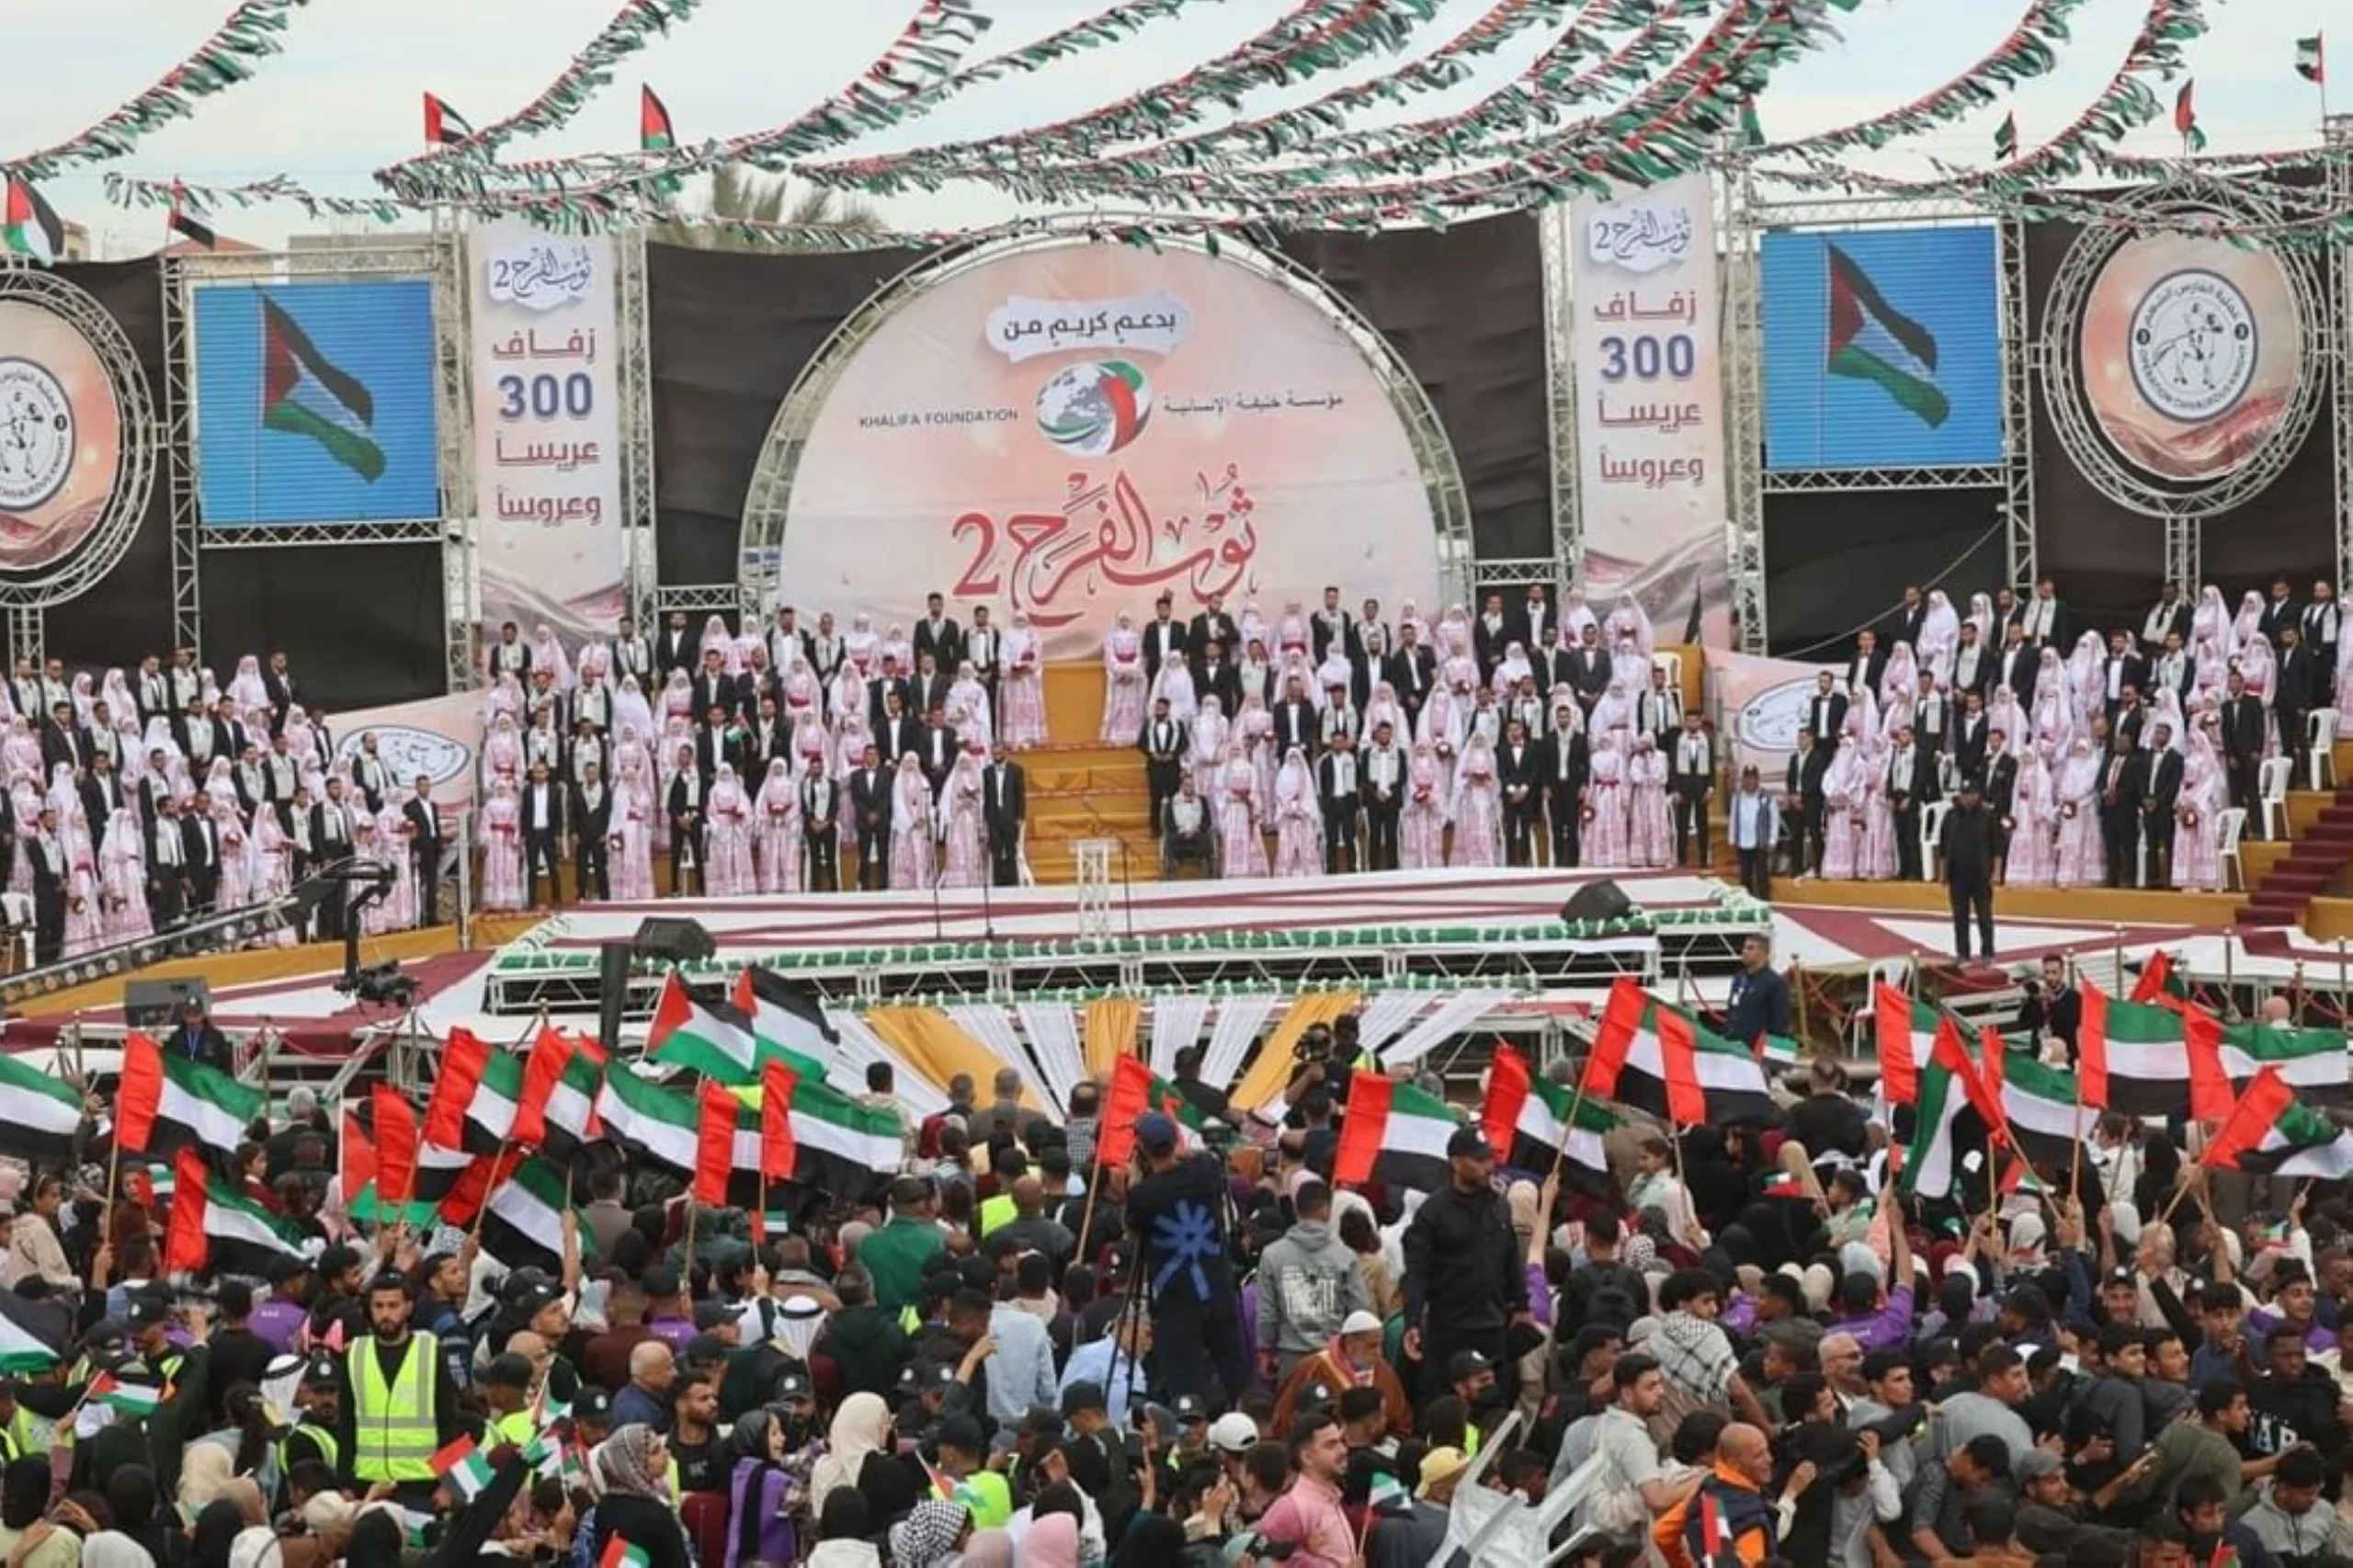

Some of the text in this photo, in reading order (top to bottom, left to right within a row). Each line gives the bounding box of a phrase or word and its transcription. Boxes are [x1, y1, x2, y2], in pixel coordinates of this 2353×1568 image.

[1595, 222, 1610, 248] 2
[494, 260, 510, 287] 2
[1594, 291, 1697, 324] زفاف
[1004, 319, 1042, 340] من
[493, 328, 596, 363] زفاف
[1599, 334, 1694, 380] 300
[497, 372, 594, 421] 300
[1286, 389, 1343, 410] مؤسسة
[859, 408, 1018, 428] KHALIFA FOUNDATION
[951, 513, 1001, 596] 2
